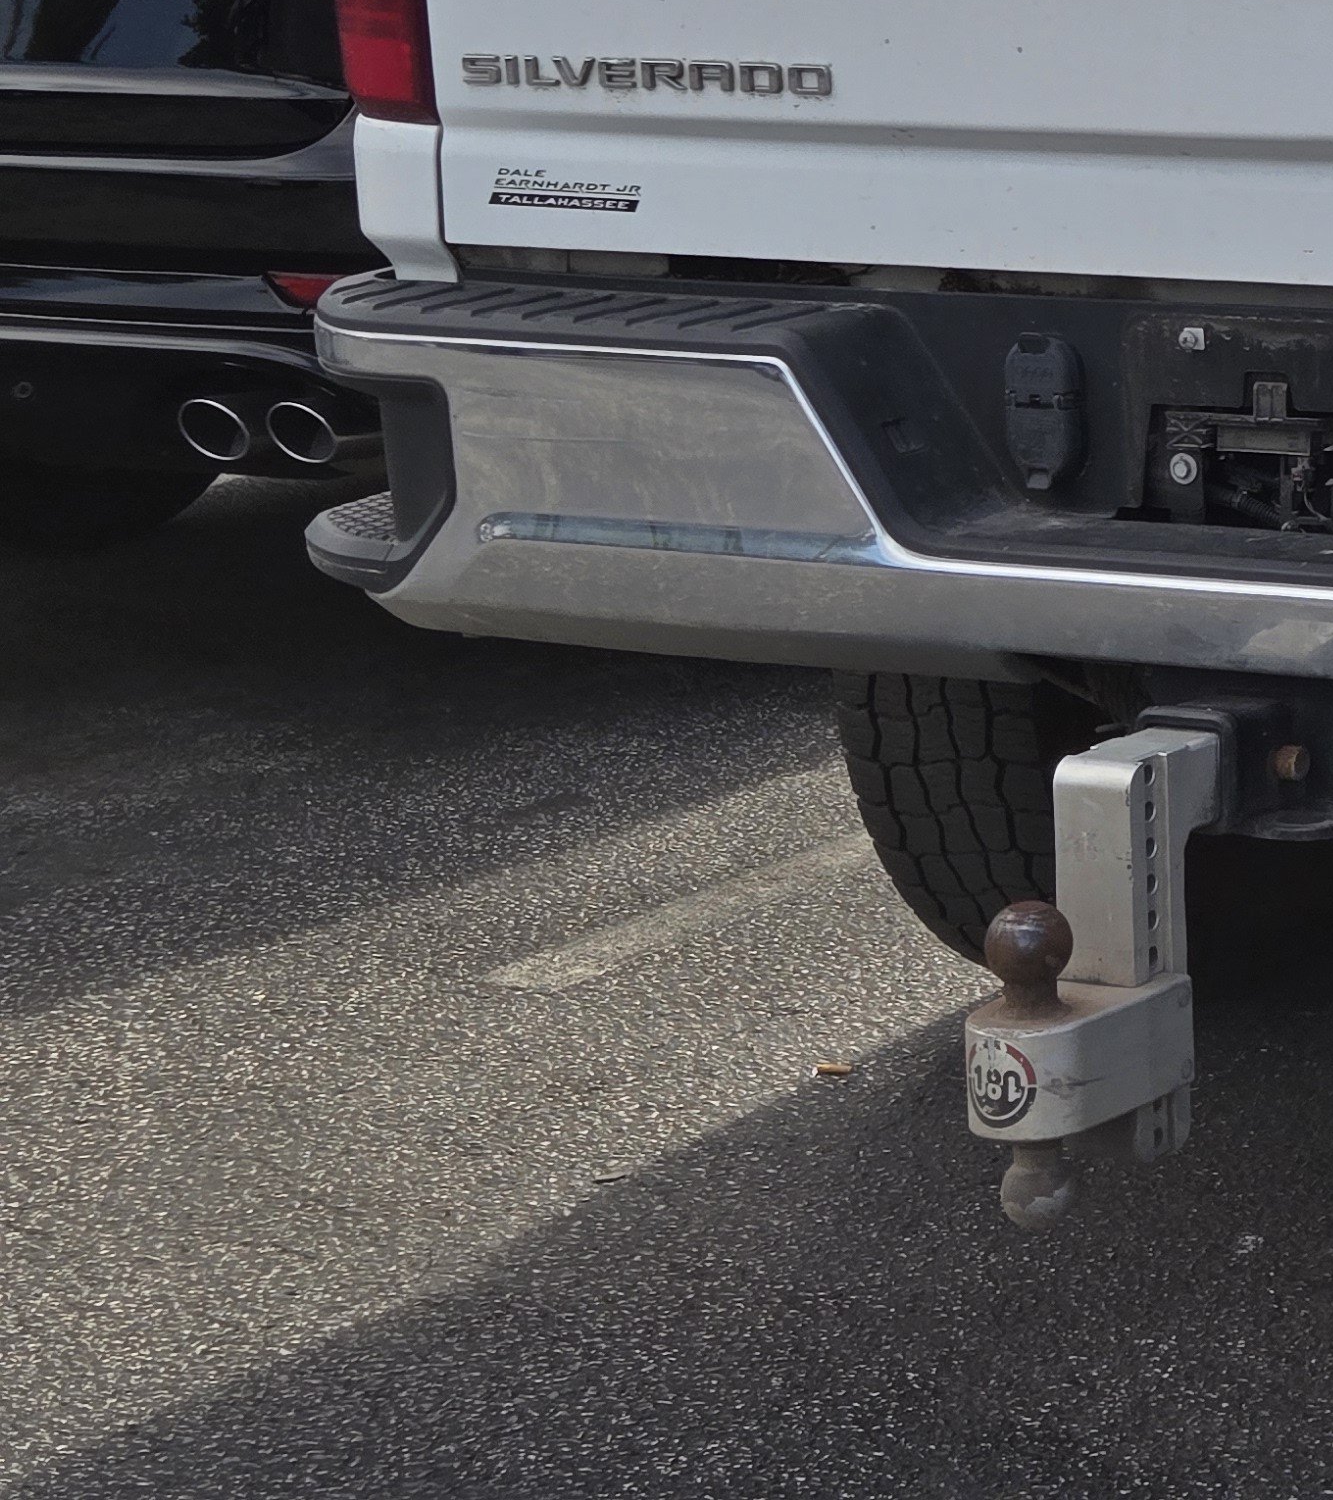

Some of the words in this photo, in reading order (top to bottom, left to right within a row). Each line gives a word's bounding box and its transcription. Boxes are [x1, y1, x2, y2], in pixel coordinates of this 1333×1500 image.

[462, 53, 833, 97] SILVERADO
[498, 168, 546, 178] DALE
[494, 178, 612, 193] EARNHARDT
[616, 185, 642, 197] JR
[498, 194, 630, 210] TALLAHASSEE
